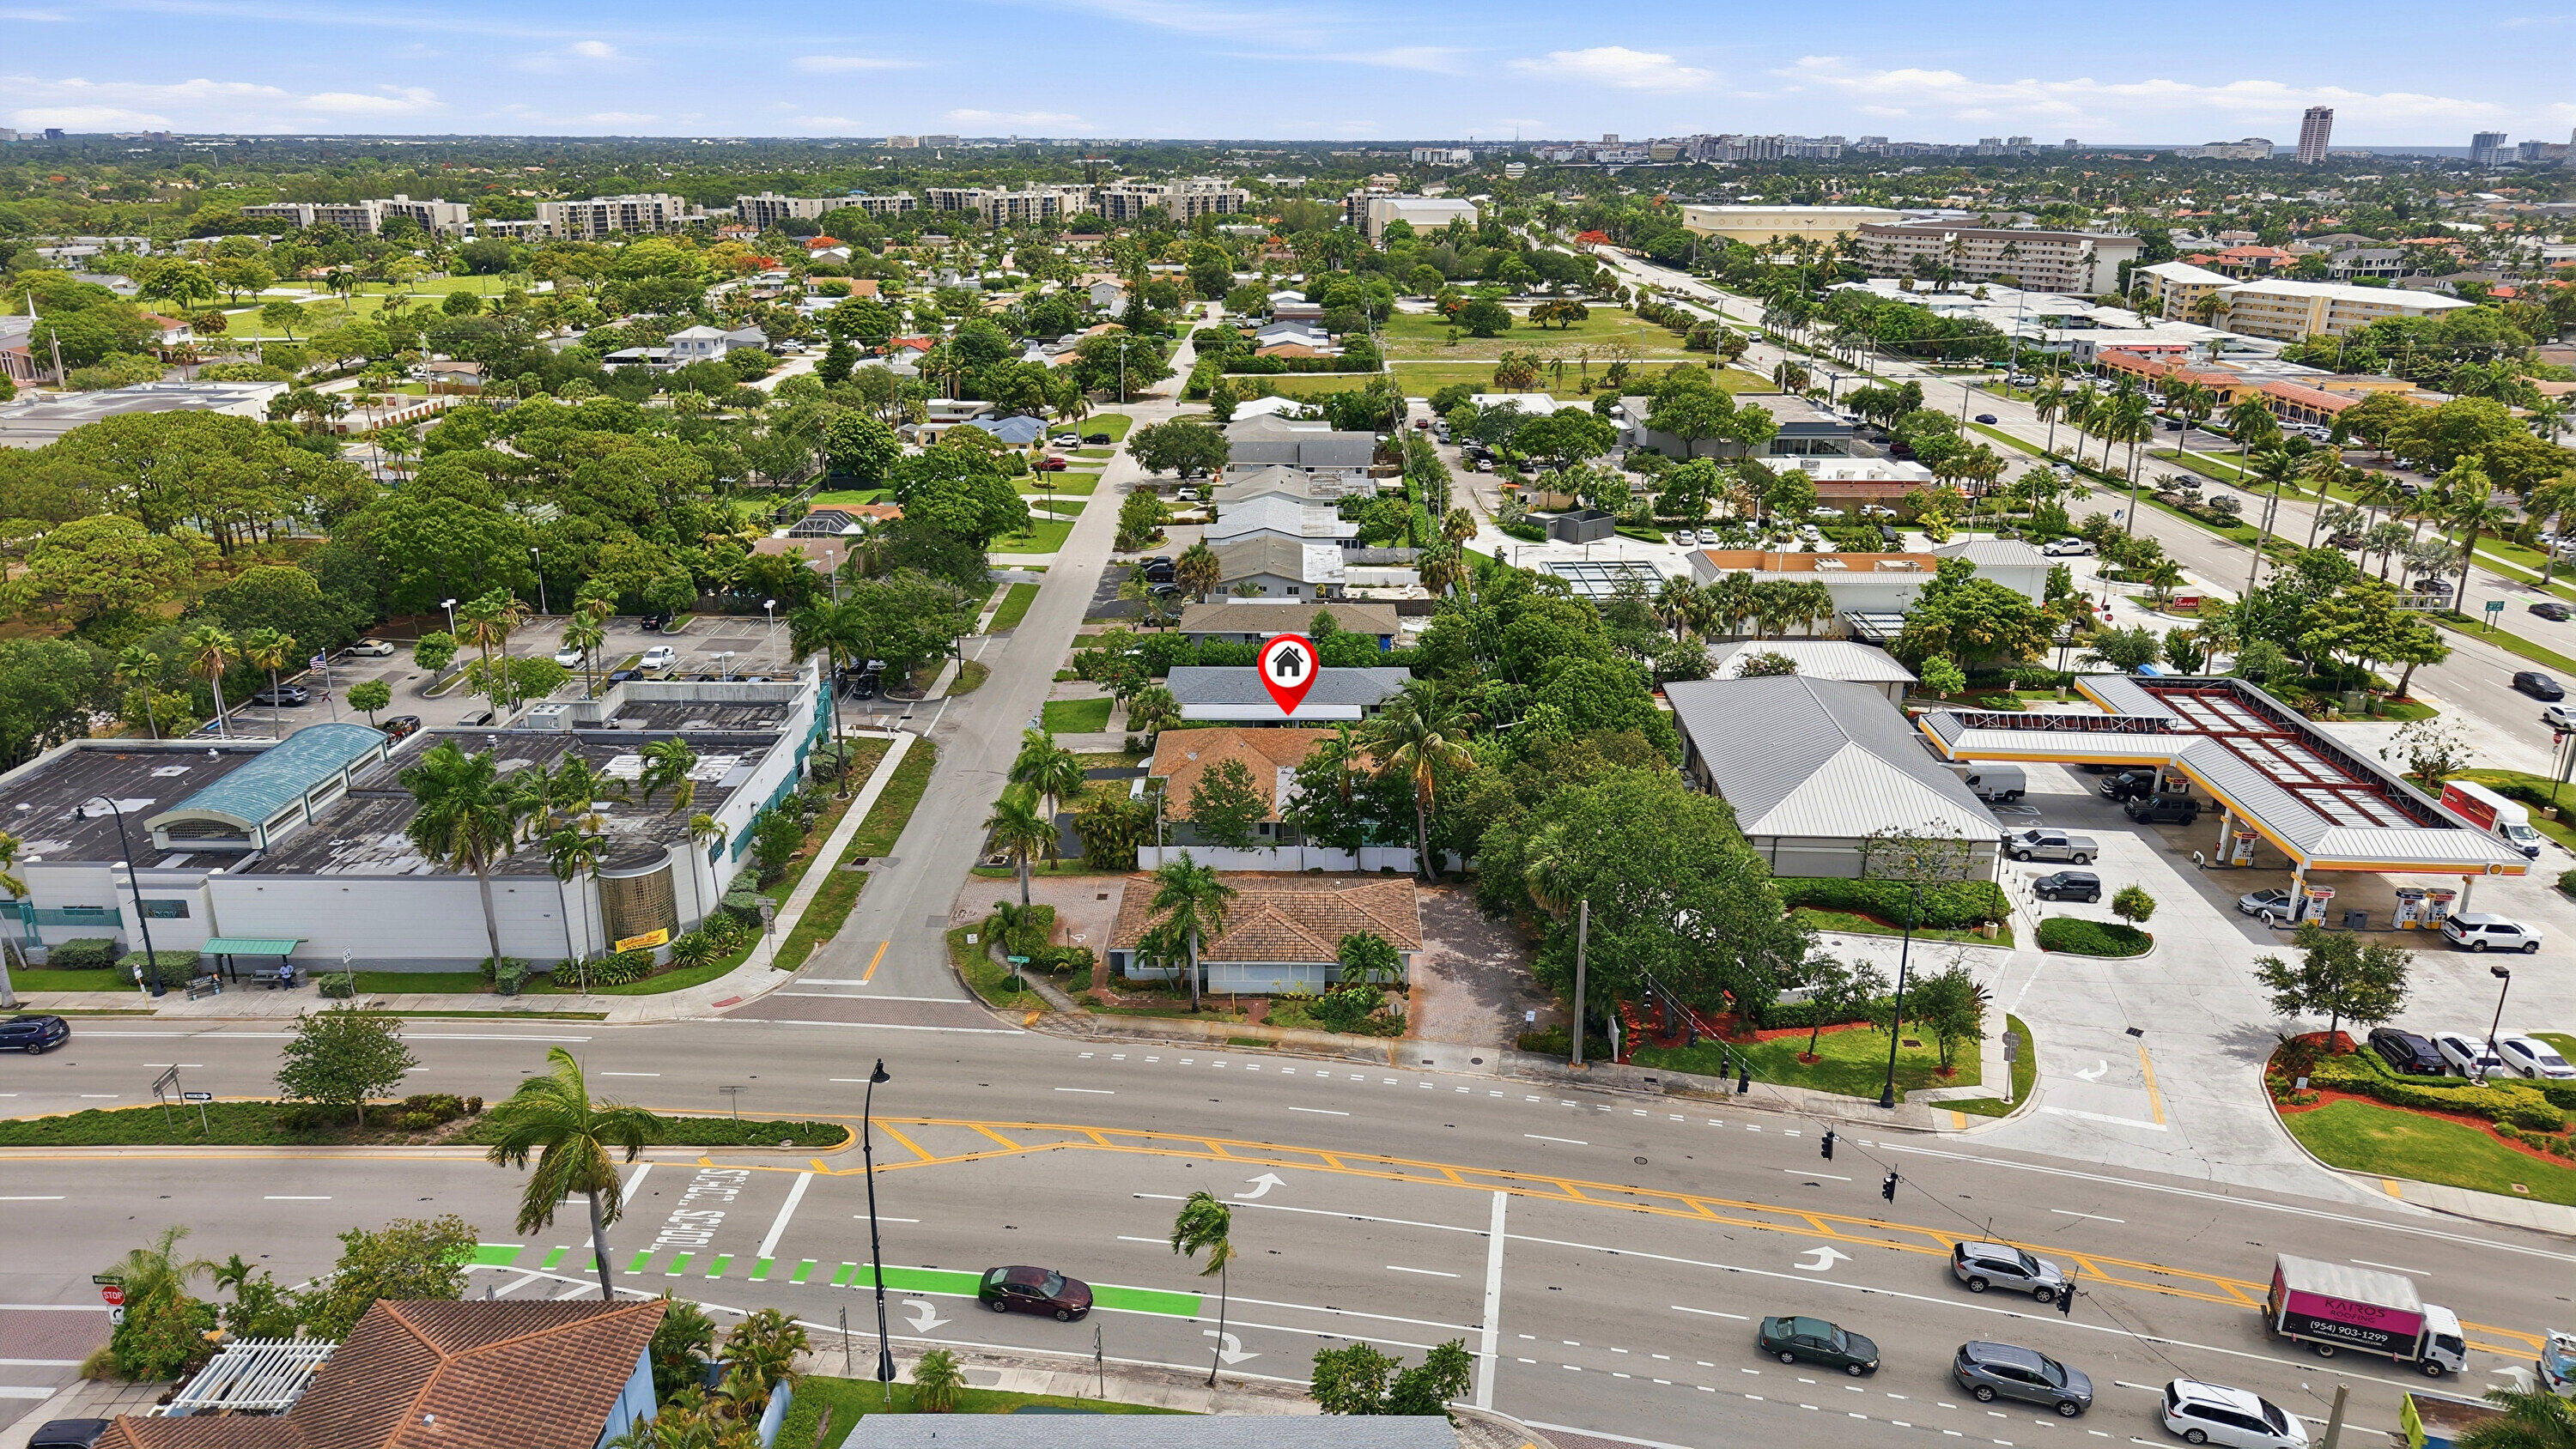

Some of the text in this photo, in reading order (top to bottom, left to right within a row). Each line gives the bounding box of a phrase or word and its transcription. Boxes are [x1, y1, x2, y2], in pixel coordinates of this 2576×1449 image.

[103, 1291, 123, 1300] STOP
[2324, 1299, 2386, 1319] KAIROS
[2310, 1320, 2336, 1333] (954)
[2338, 1326, 2388, 1342] 903-1299
